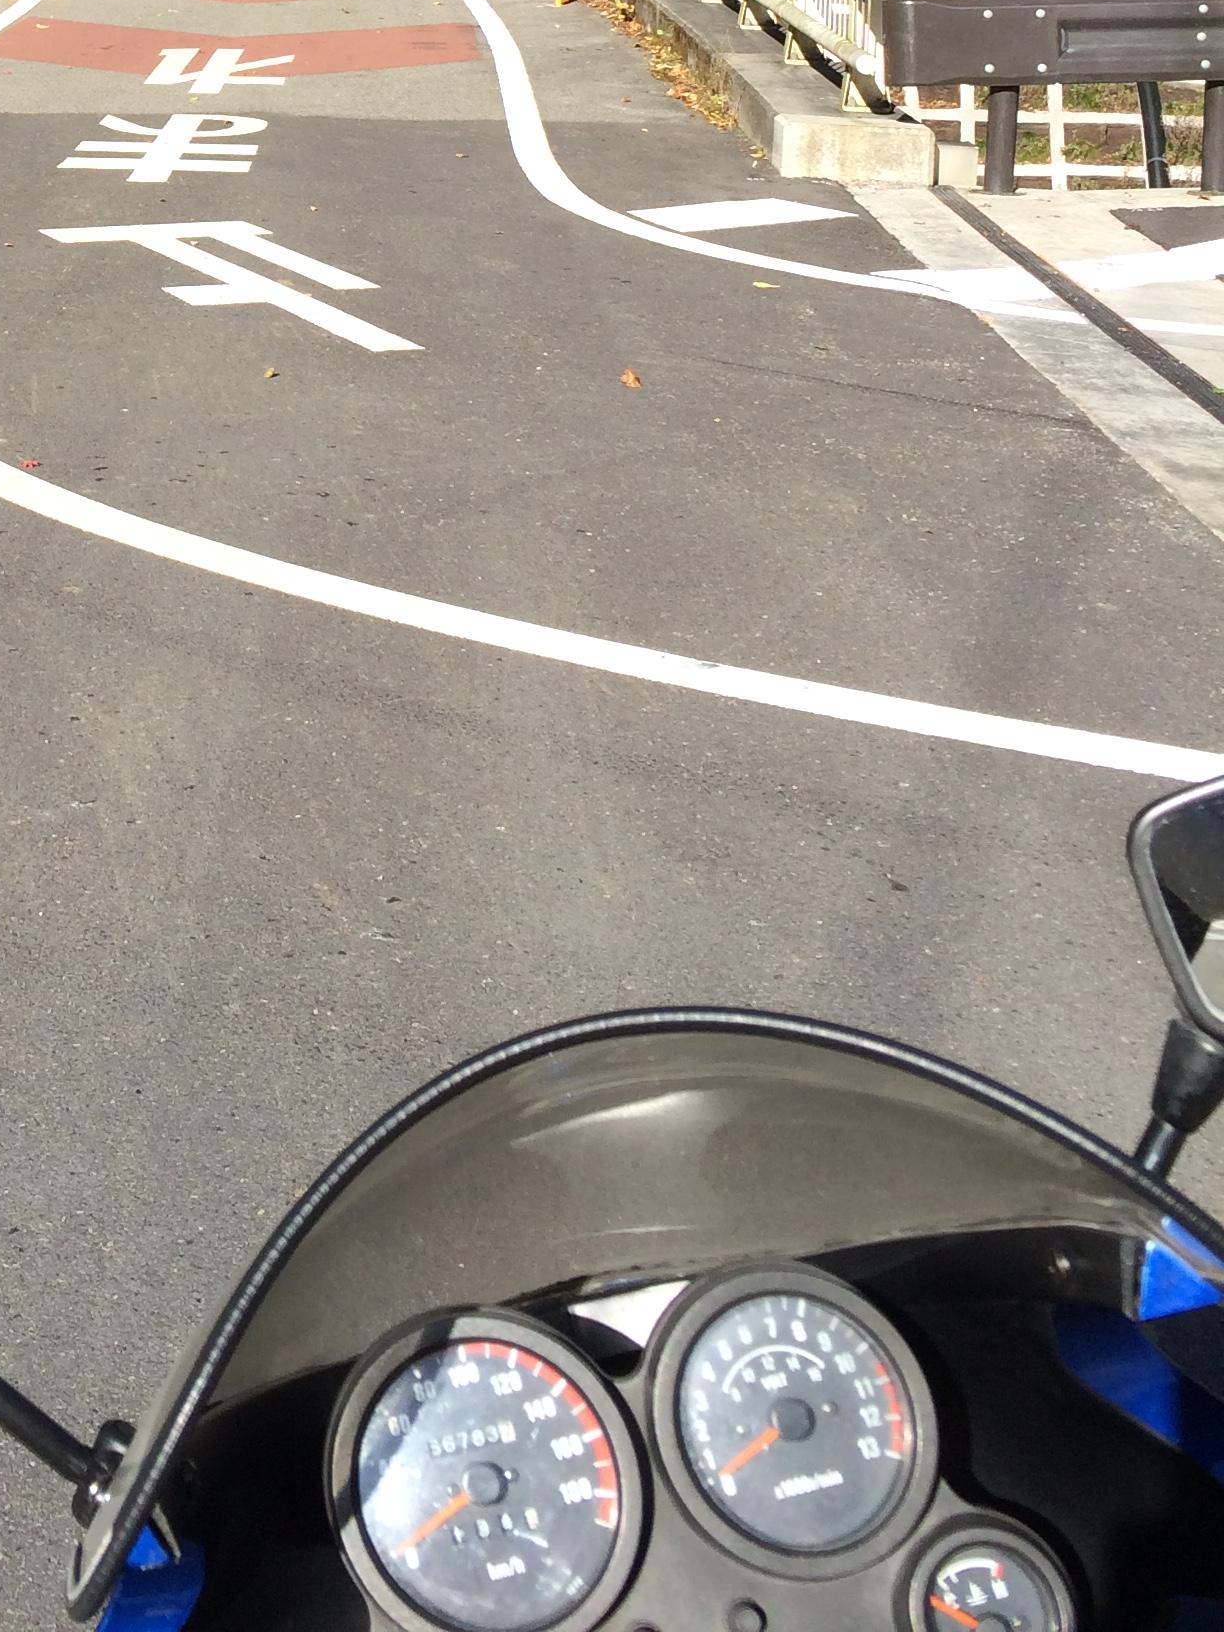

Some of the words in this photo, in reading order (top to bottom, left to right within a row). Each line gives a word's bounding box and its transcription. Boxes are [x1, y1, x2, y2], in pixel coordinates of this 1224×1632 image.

[763, 1316, 778, 1339] 7
[816, 1331, 833, 1353] 9
[833, 1352, 856, 1375] 10
[489, 1370, 523, 1396] 120
[853, 1376, 875, 1400] 11
[523, 1396, 557, 1423] 140
[859, 1405, 883, 1428] 12
[857, 1435, 881, 1460] 13
[486, 1555, 526, 1581] km/h
